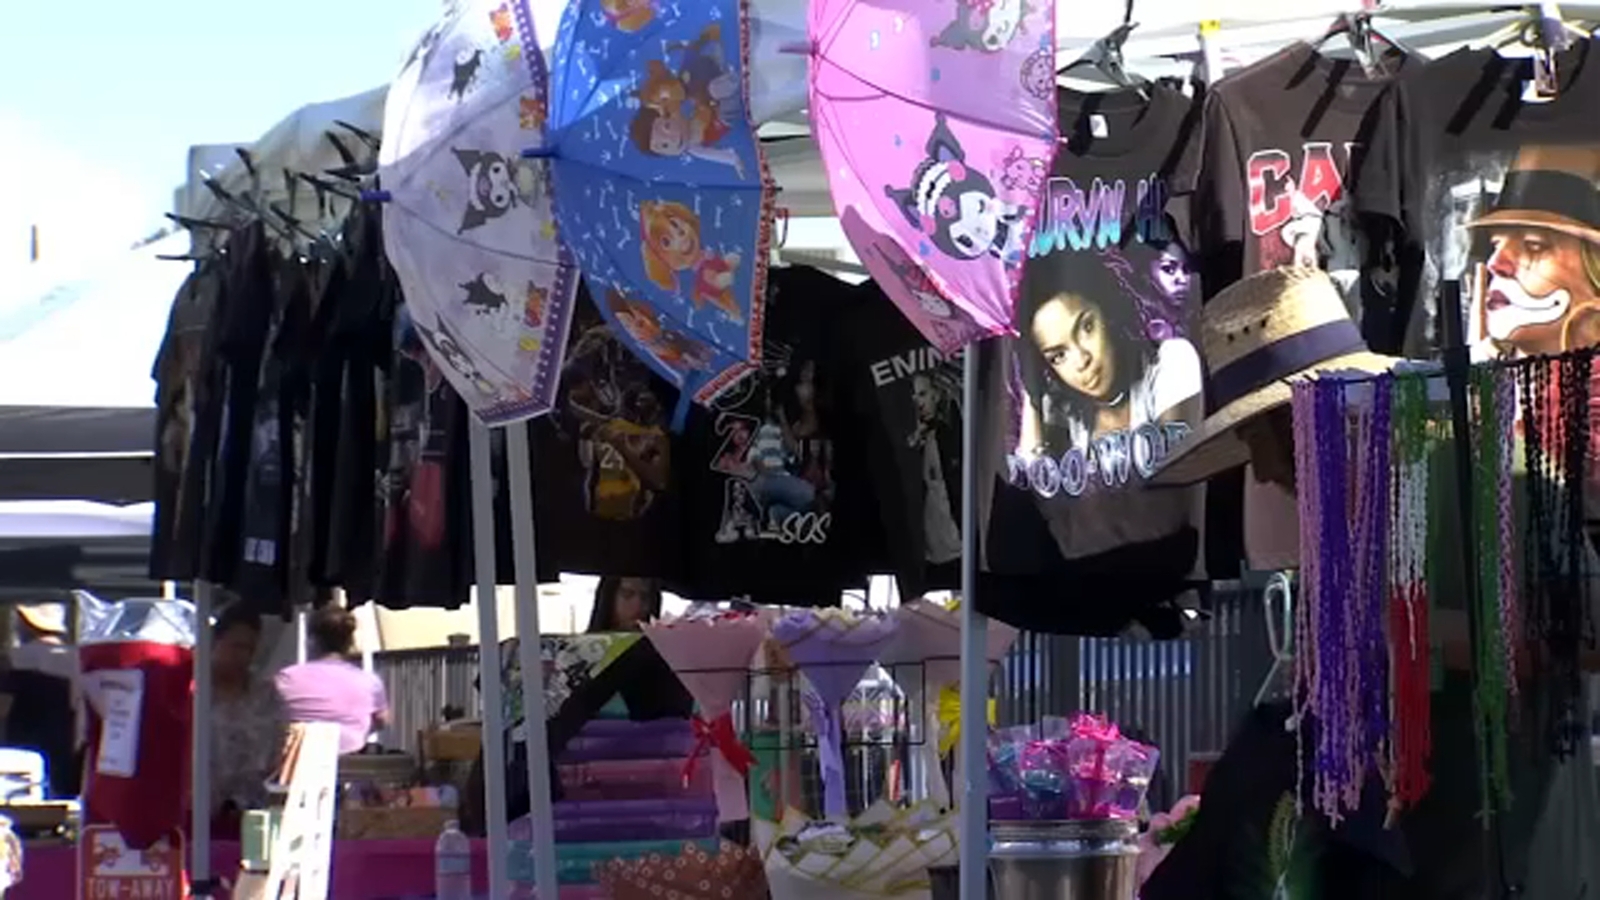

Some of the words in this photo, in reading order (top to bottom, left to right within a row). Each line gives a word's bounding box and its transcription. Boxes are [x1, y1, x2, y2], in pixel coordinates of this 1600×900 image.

[1247, 142, 1363, 235] CA
[1027, 177, 1126, 258] URYN
[778, 512, 831, 543] SOS
[86, 878, 175, 900] TOW-AWAY
